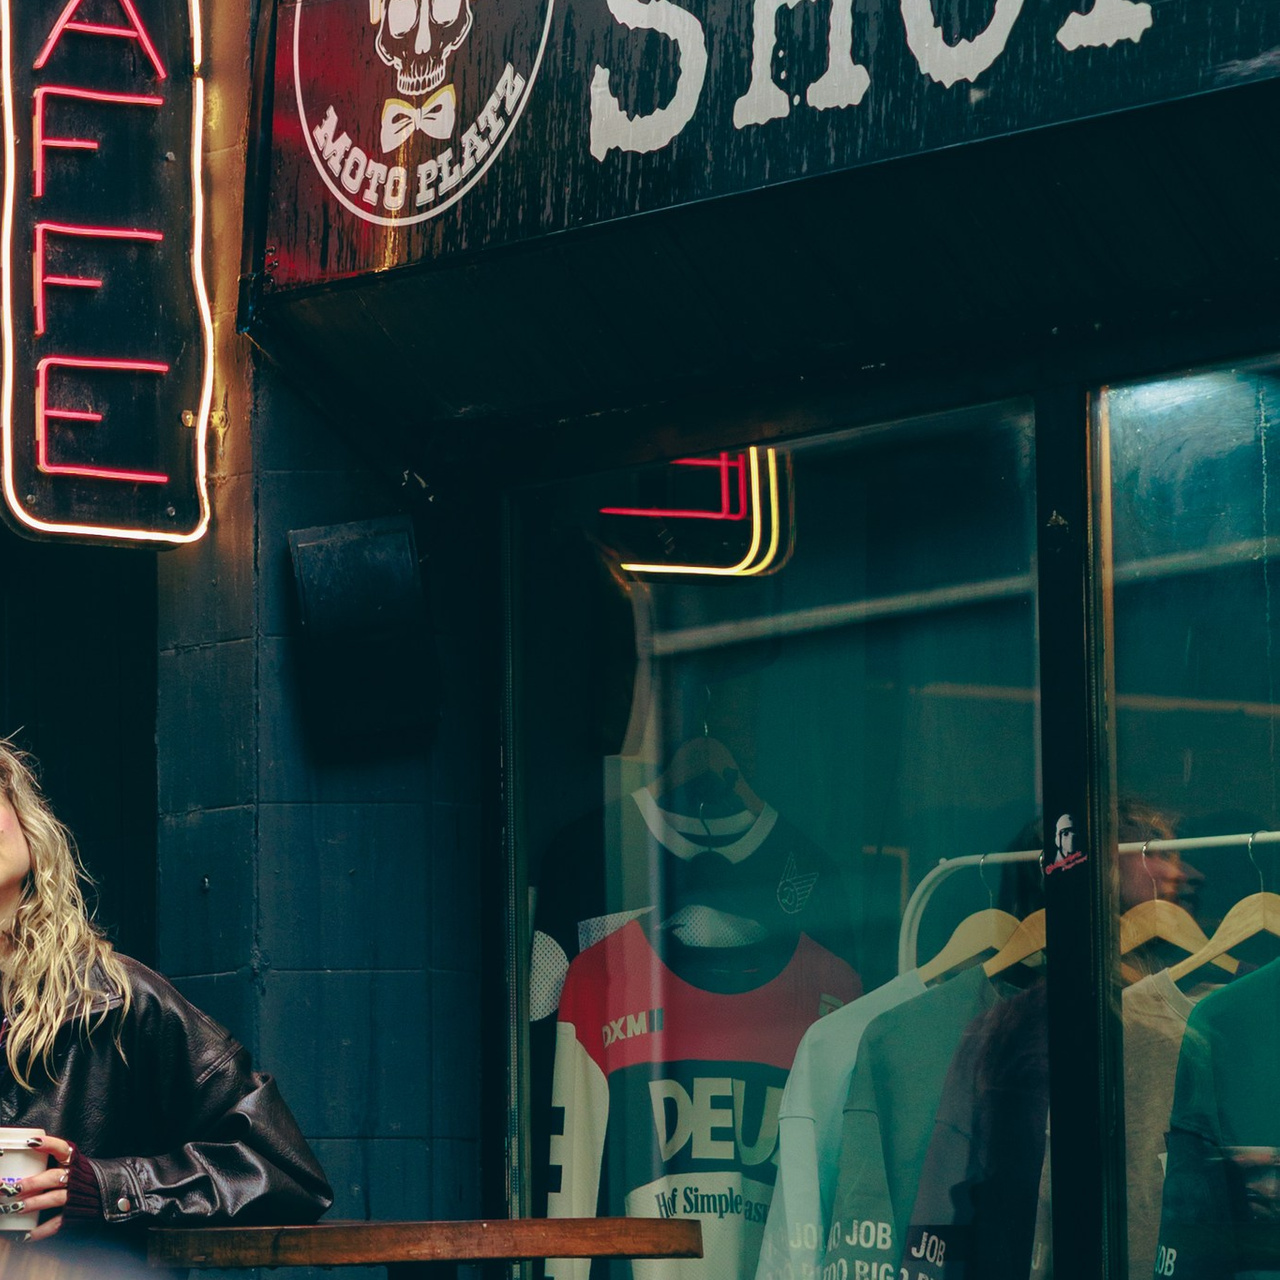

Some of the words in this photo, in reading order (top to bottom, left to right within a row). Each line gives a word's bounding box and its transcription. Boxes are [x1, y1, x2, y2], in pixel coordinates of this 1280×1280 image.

[312, 104, 407, 212] MOTO
[415, 61, 526, 207] PLATZ
[648, 1076, 781, 1166] DEU
[683, 1186, 742, 1219] Simple
[845, 1219, 892, 1251] JOB
[911, 1231, 947, 1268] JOB
[1154, 1245, 1178, 1277] OB
